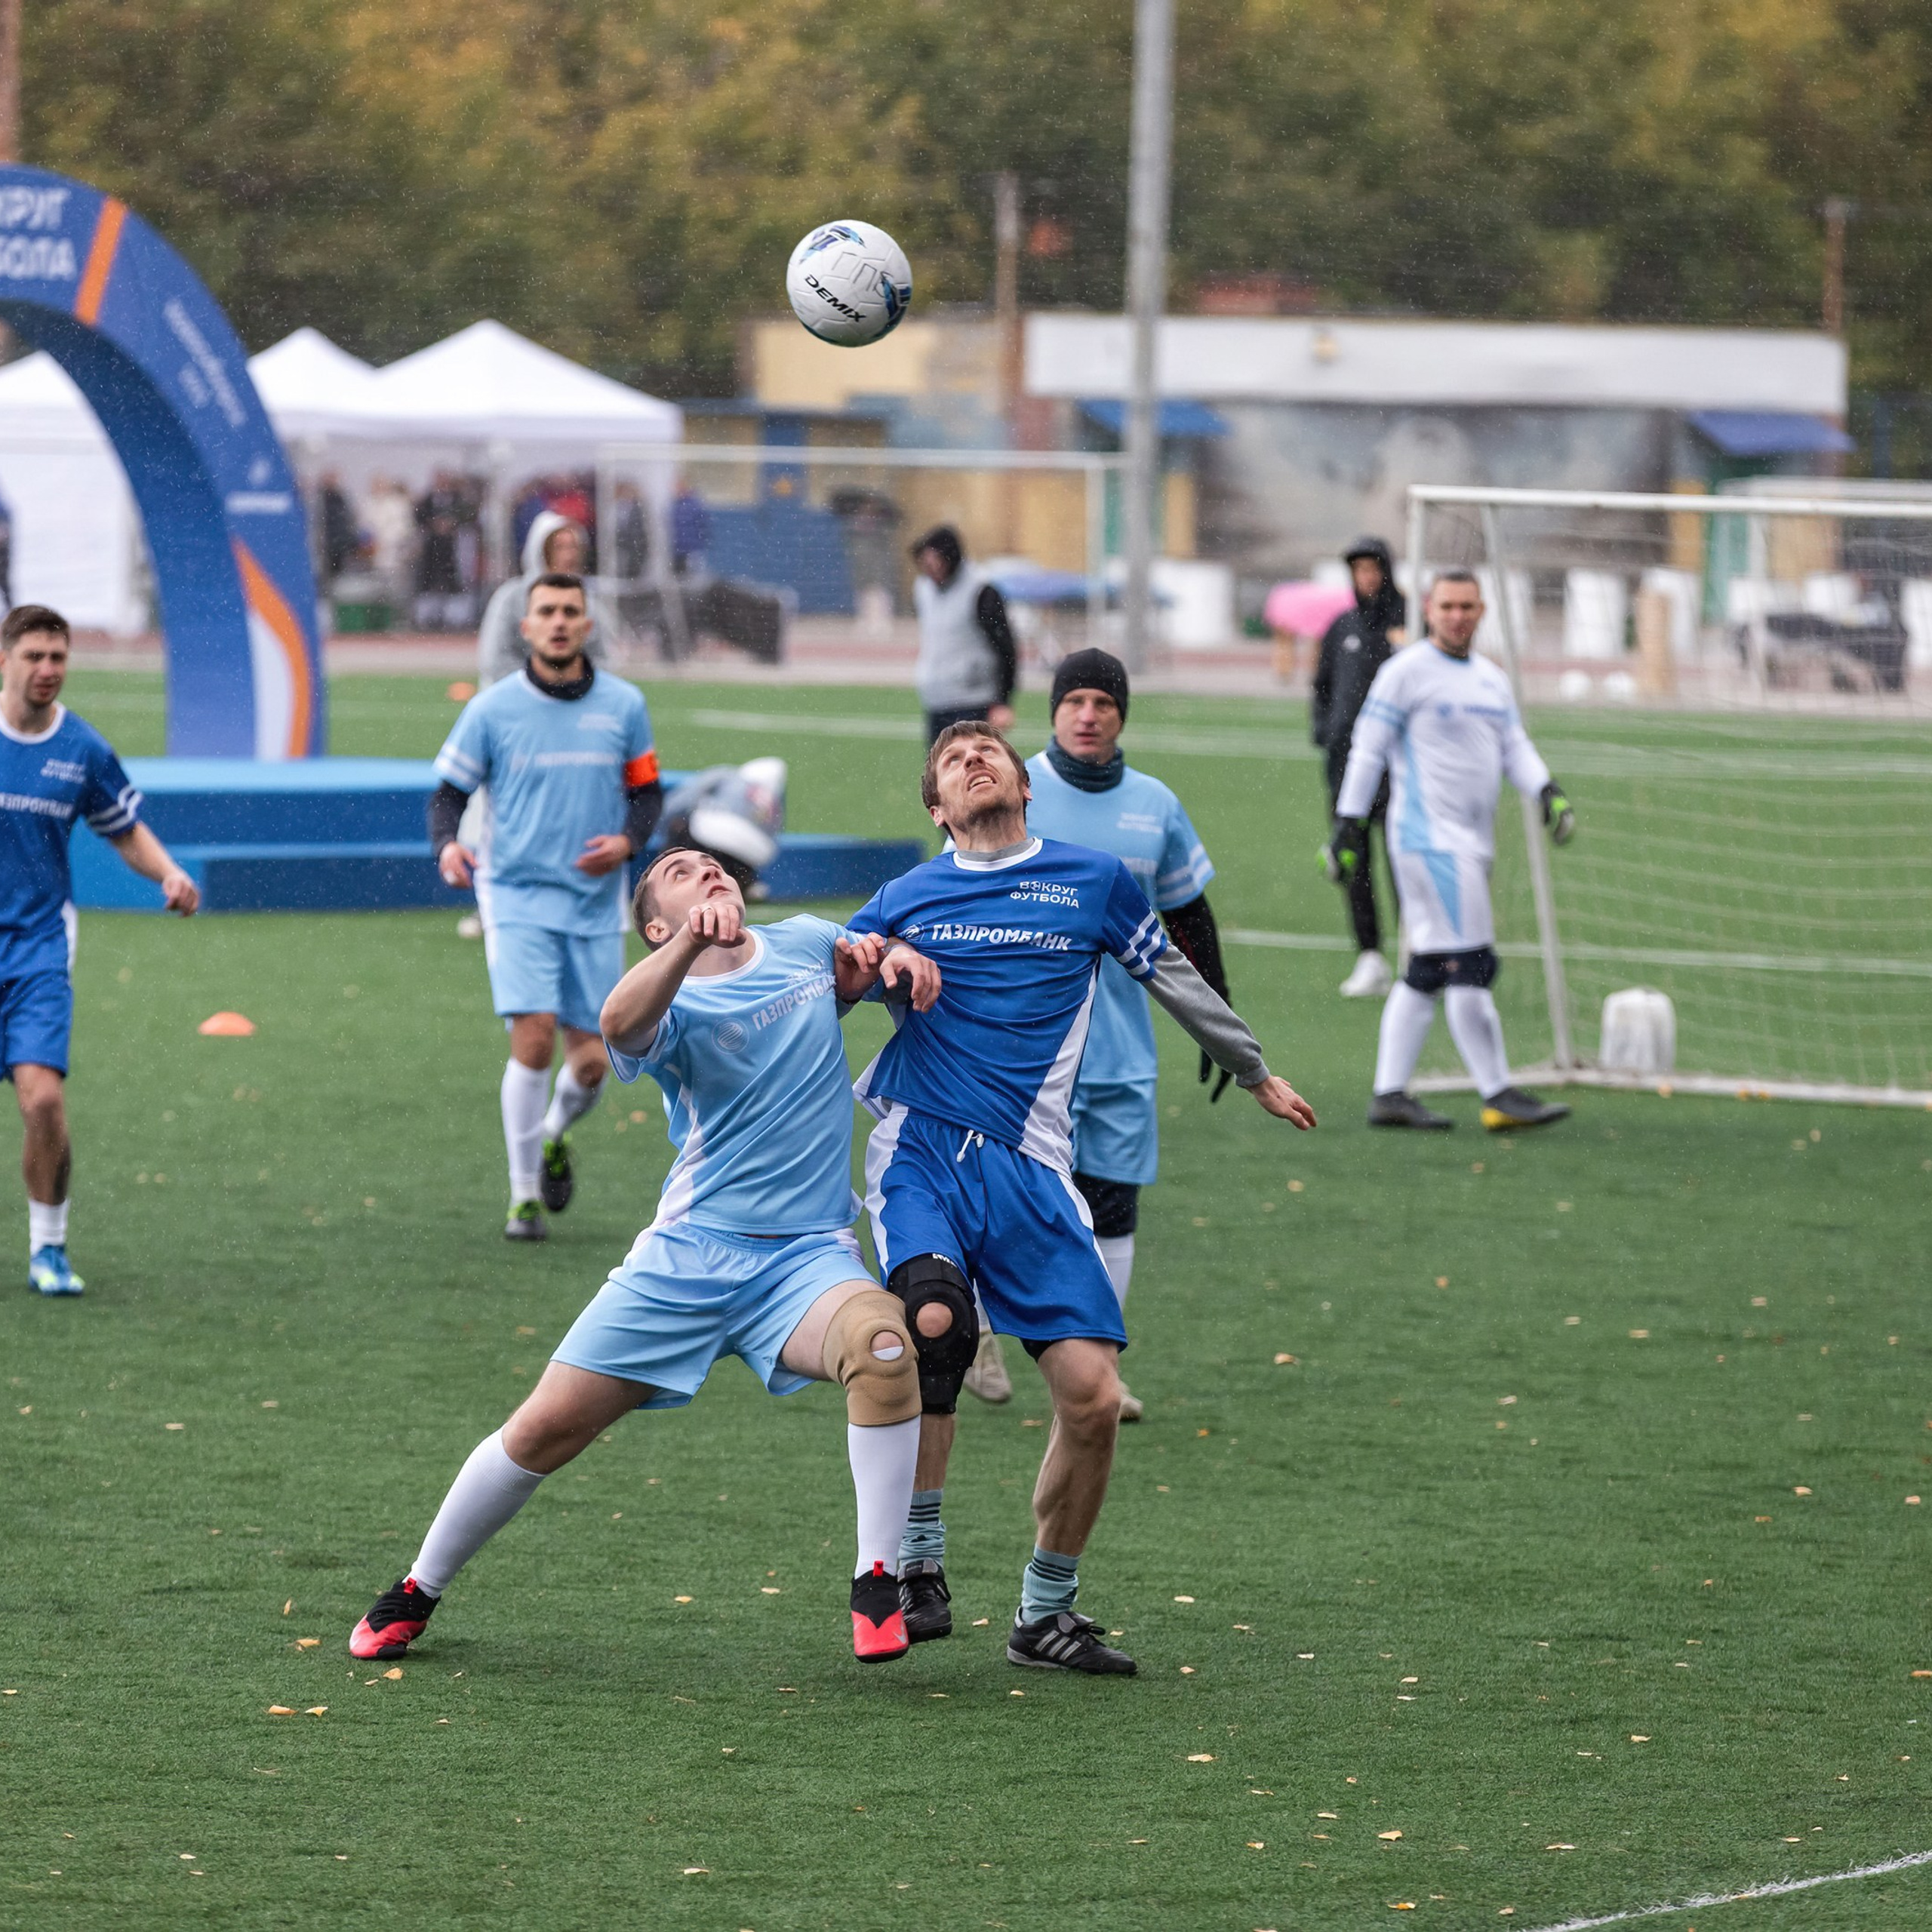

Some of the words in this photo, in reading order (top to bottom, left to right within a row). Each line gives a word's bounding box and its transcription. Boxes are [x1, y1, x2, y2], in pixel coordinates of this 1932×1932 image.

[804, 274, 866, 322] DEMIX
[1020, 881, 1078, 896] ВОКРУГ
[1010, 891, 1079, 909] ФУТБОЛА
[932, 923, 1072, 950] ГАЗПРОМБАНК
